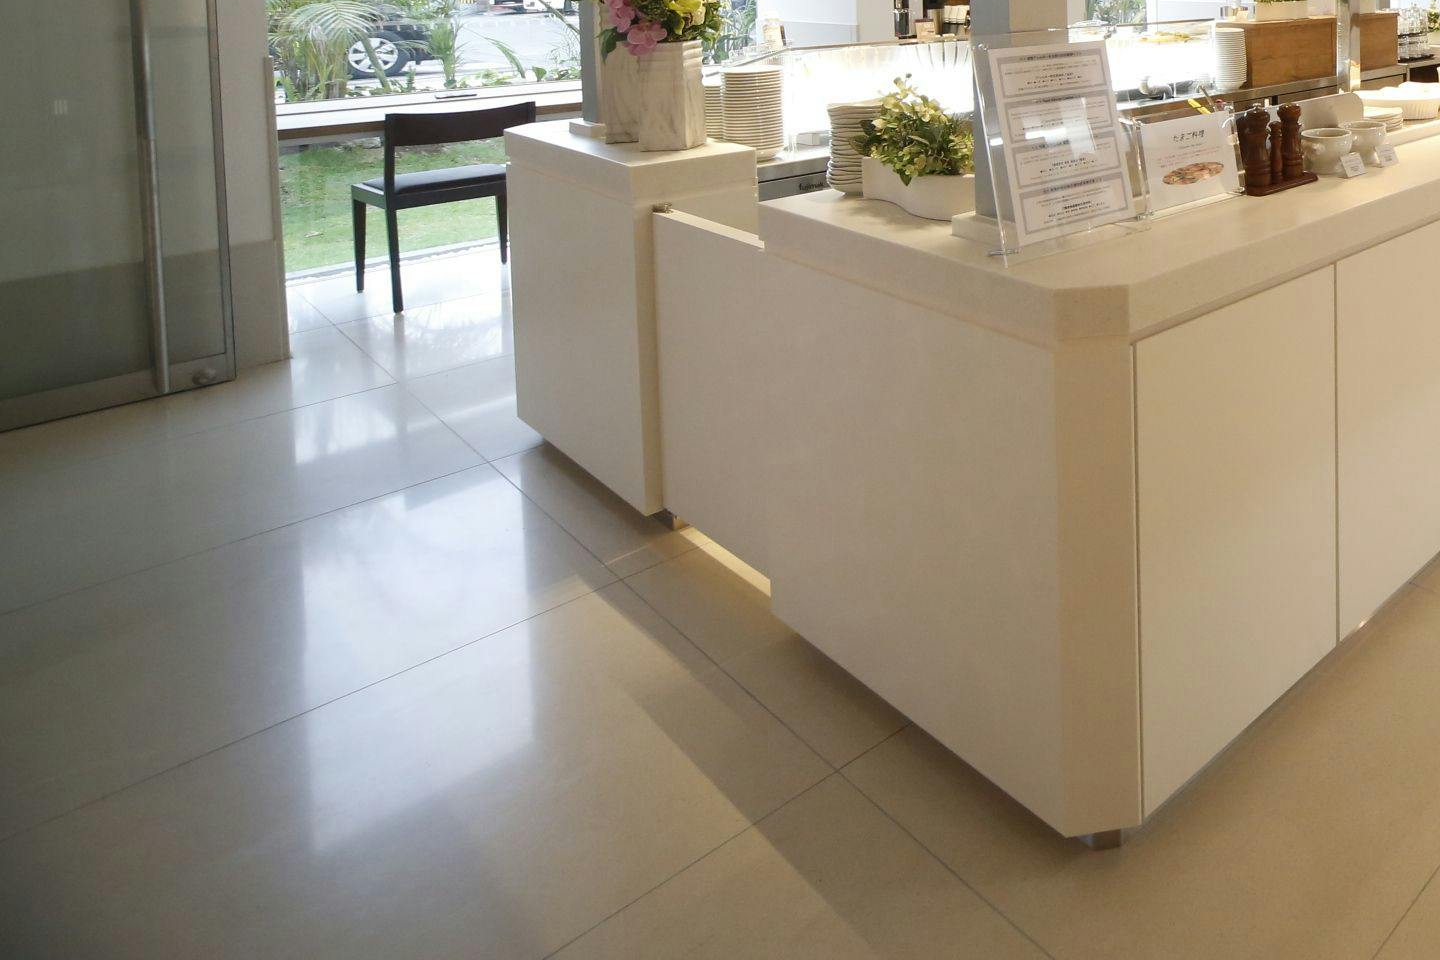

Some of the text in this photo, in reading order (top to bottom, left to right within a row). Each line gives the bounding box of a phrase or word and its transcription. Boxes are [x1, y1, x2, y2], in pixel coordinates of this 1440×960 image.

[1173, 129, 1205, 143] たまご料理
